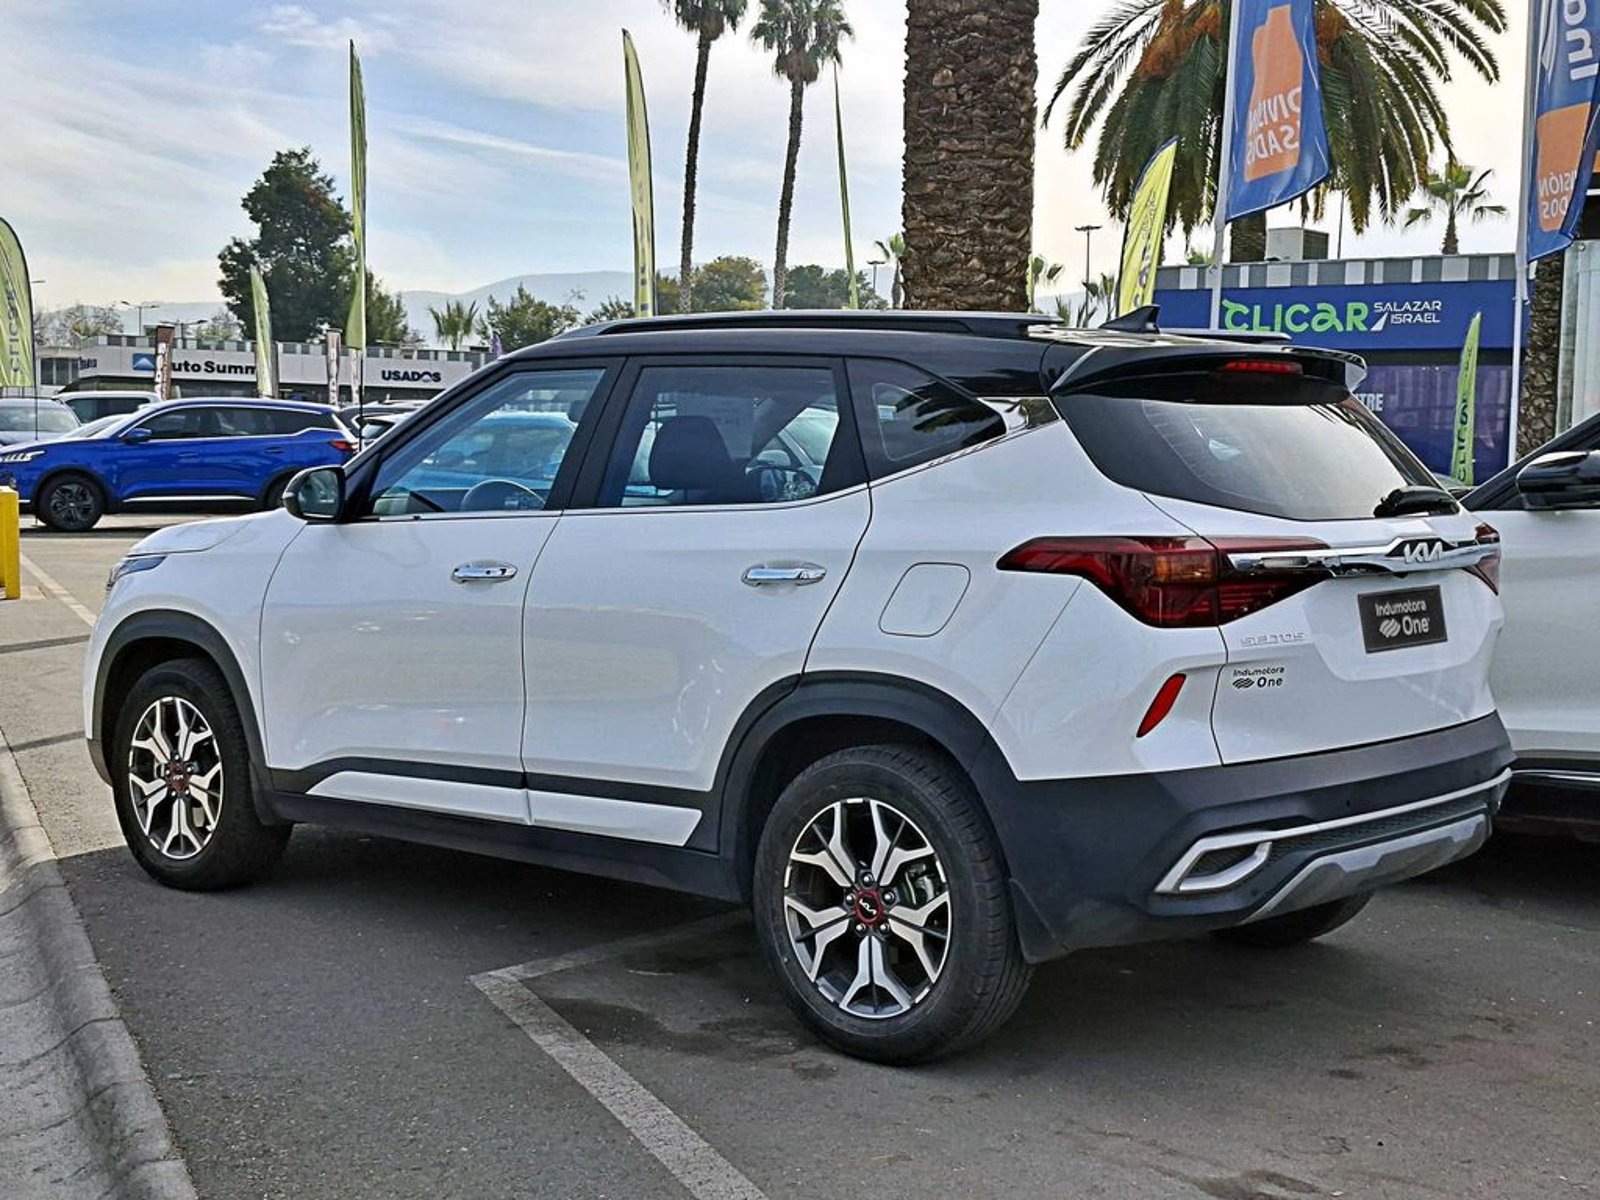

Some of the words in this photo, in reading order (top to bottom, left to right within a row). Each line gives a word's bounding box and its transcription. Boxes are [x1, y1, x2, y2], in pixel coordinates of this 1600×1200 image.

[1373, 300, 1442, 313] SALAZAR
[1390, 312, 1441, 324] ISRAEL
[171, 360, 201, 374] uto
[204, 360, 257, 375] Summ
[381, 370, 441, 382] USADOS
[1353, 393, 1384, 412] TRE
[1403, 541, 1444, 564] KIA
[1375, 600, 1427, 617] Indumotora
[1402, 615, 1429, 636] One
[1233, 667, 1285, 677] Indumotora
[1257, 676, 1283, 688] One
